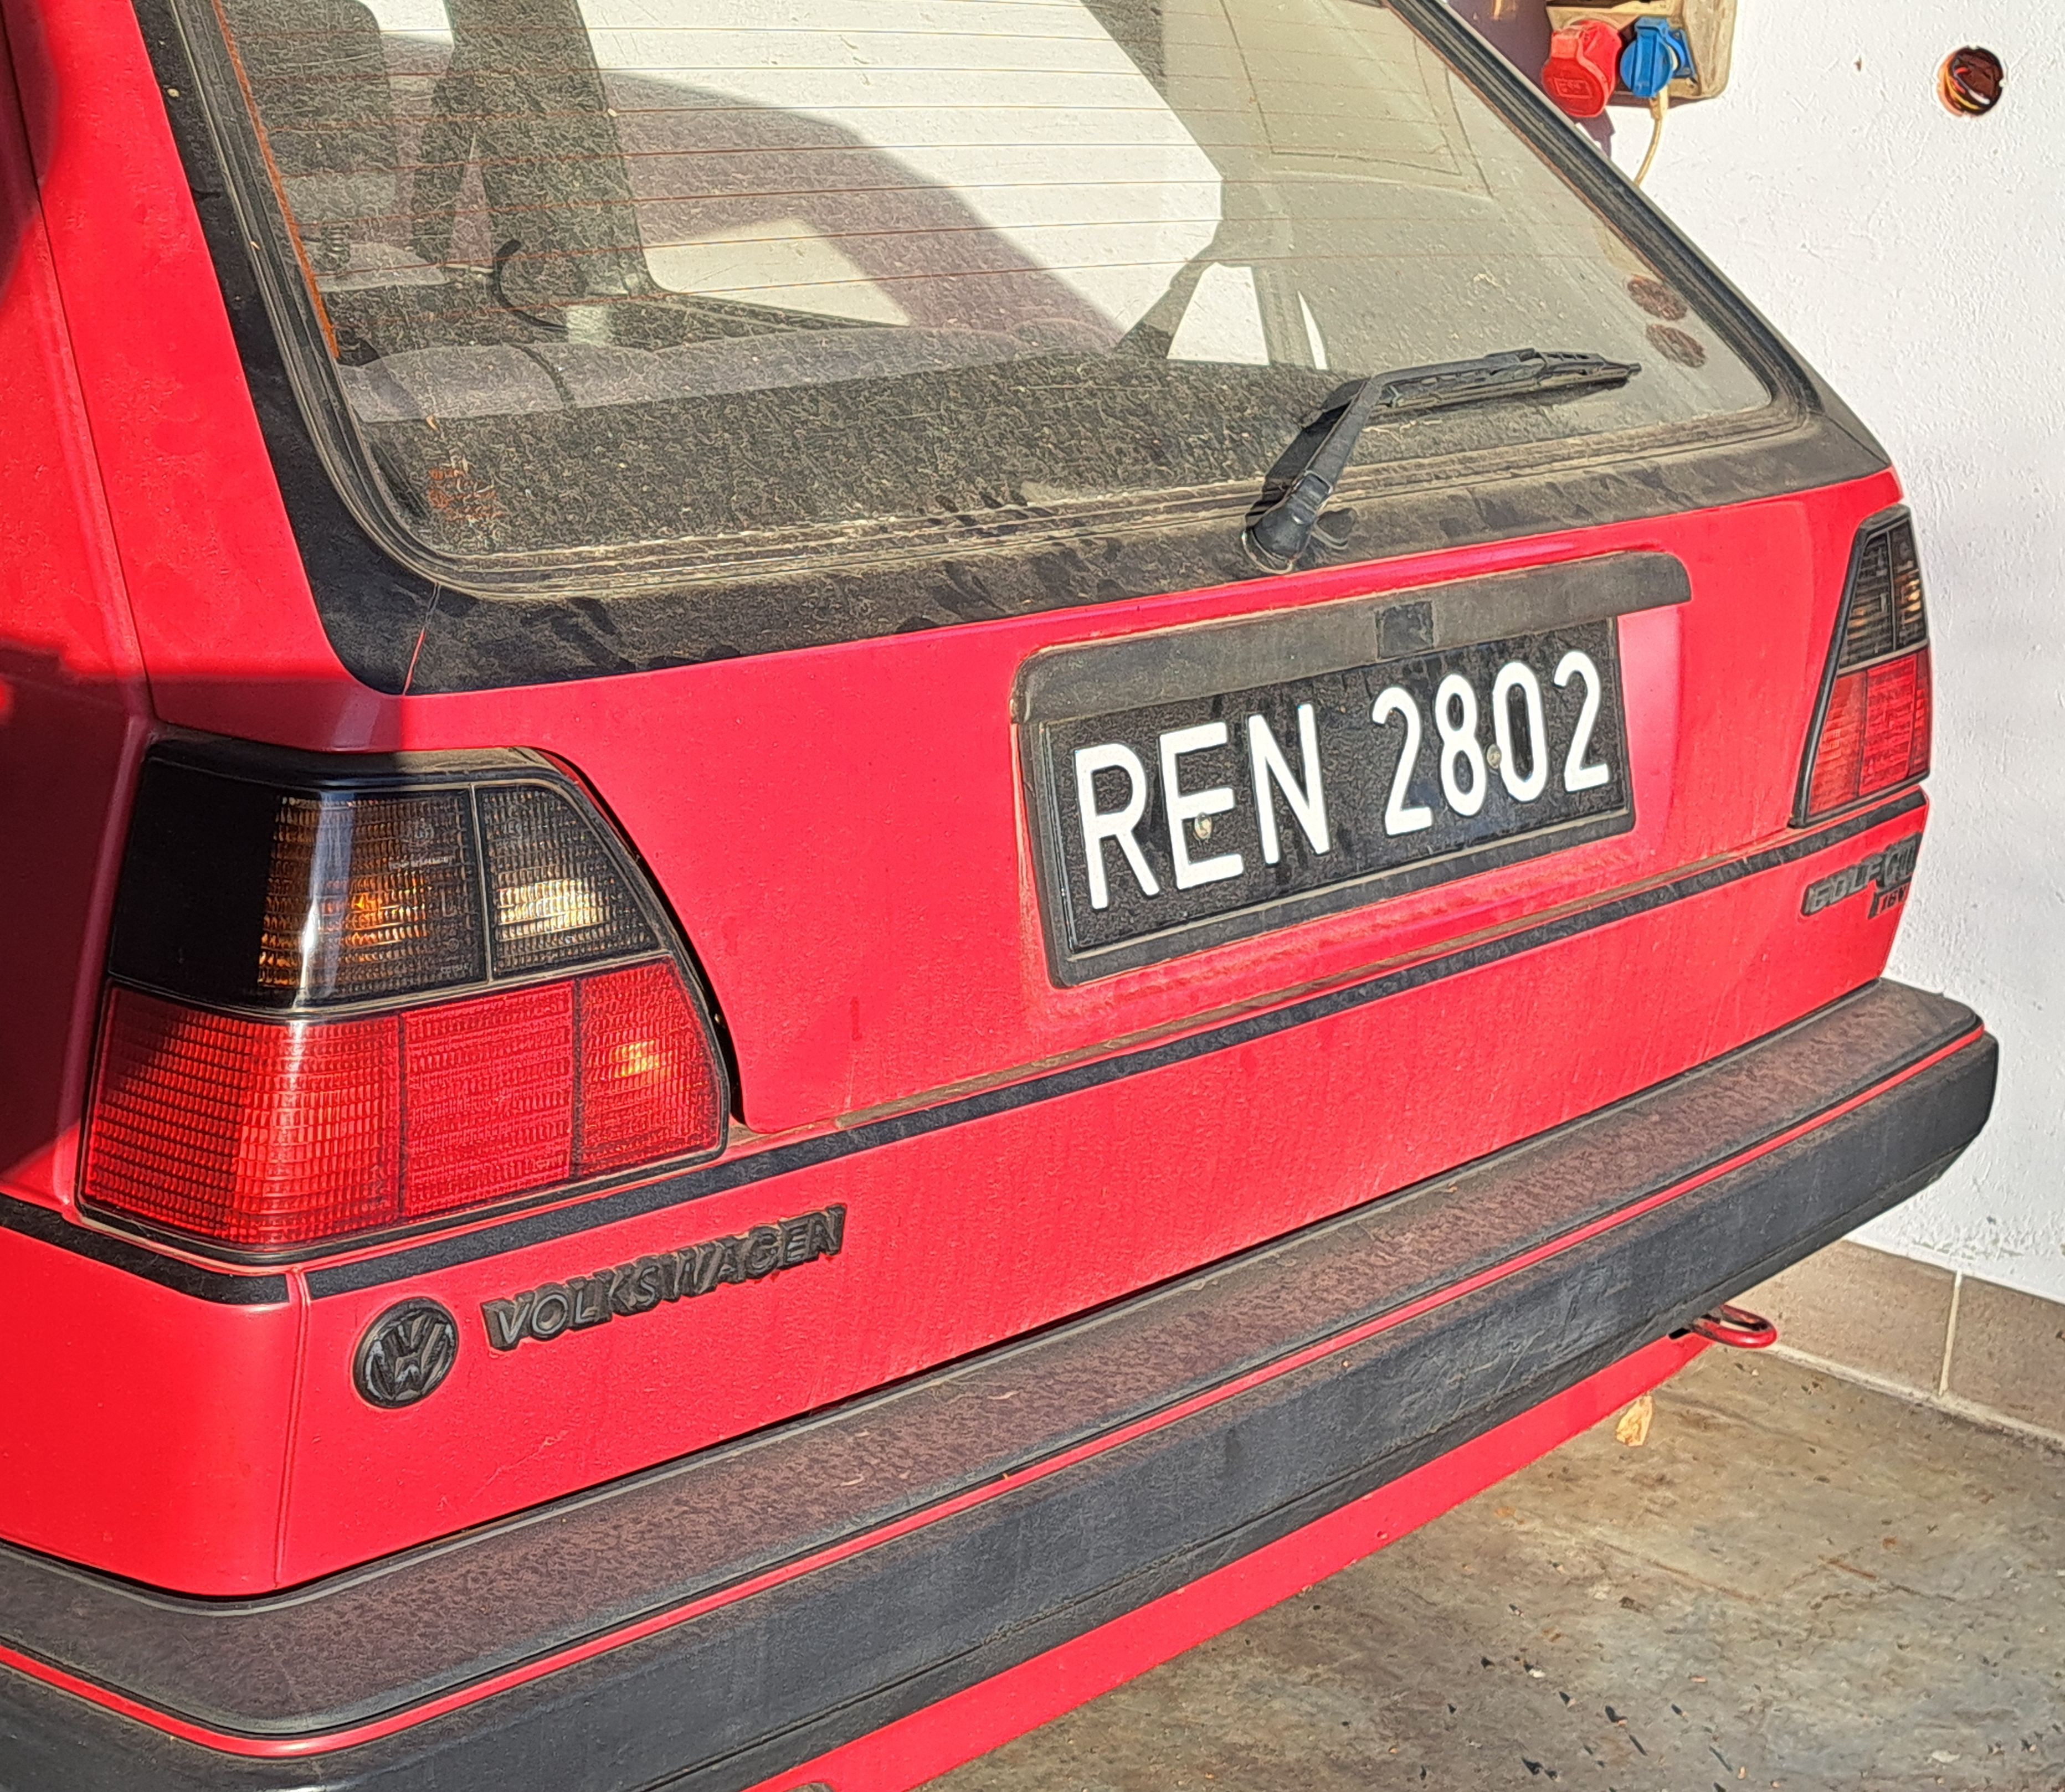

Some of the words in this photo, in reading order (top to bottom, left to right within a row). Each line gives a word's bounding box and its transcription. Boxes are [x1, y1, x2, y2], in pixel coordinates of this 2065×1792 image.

[1073, 702, 1331, 909] REN
[1371, 650, 1610, 836] 2802
[1801, 854, 1883, 915] GOLF
[480, 1203, 846, 1351] VOLKSWAGEN
[353, 1297, 459, 1408] VW
